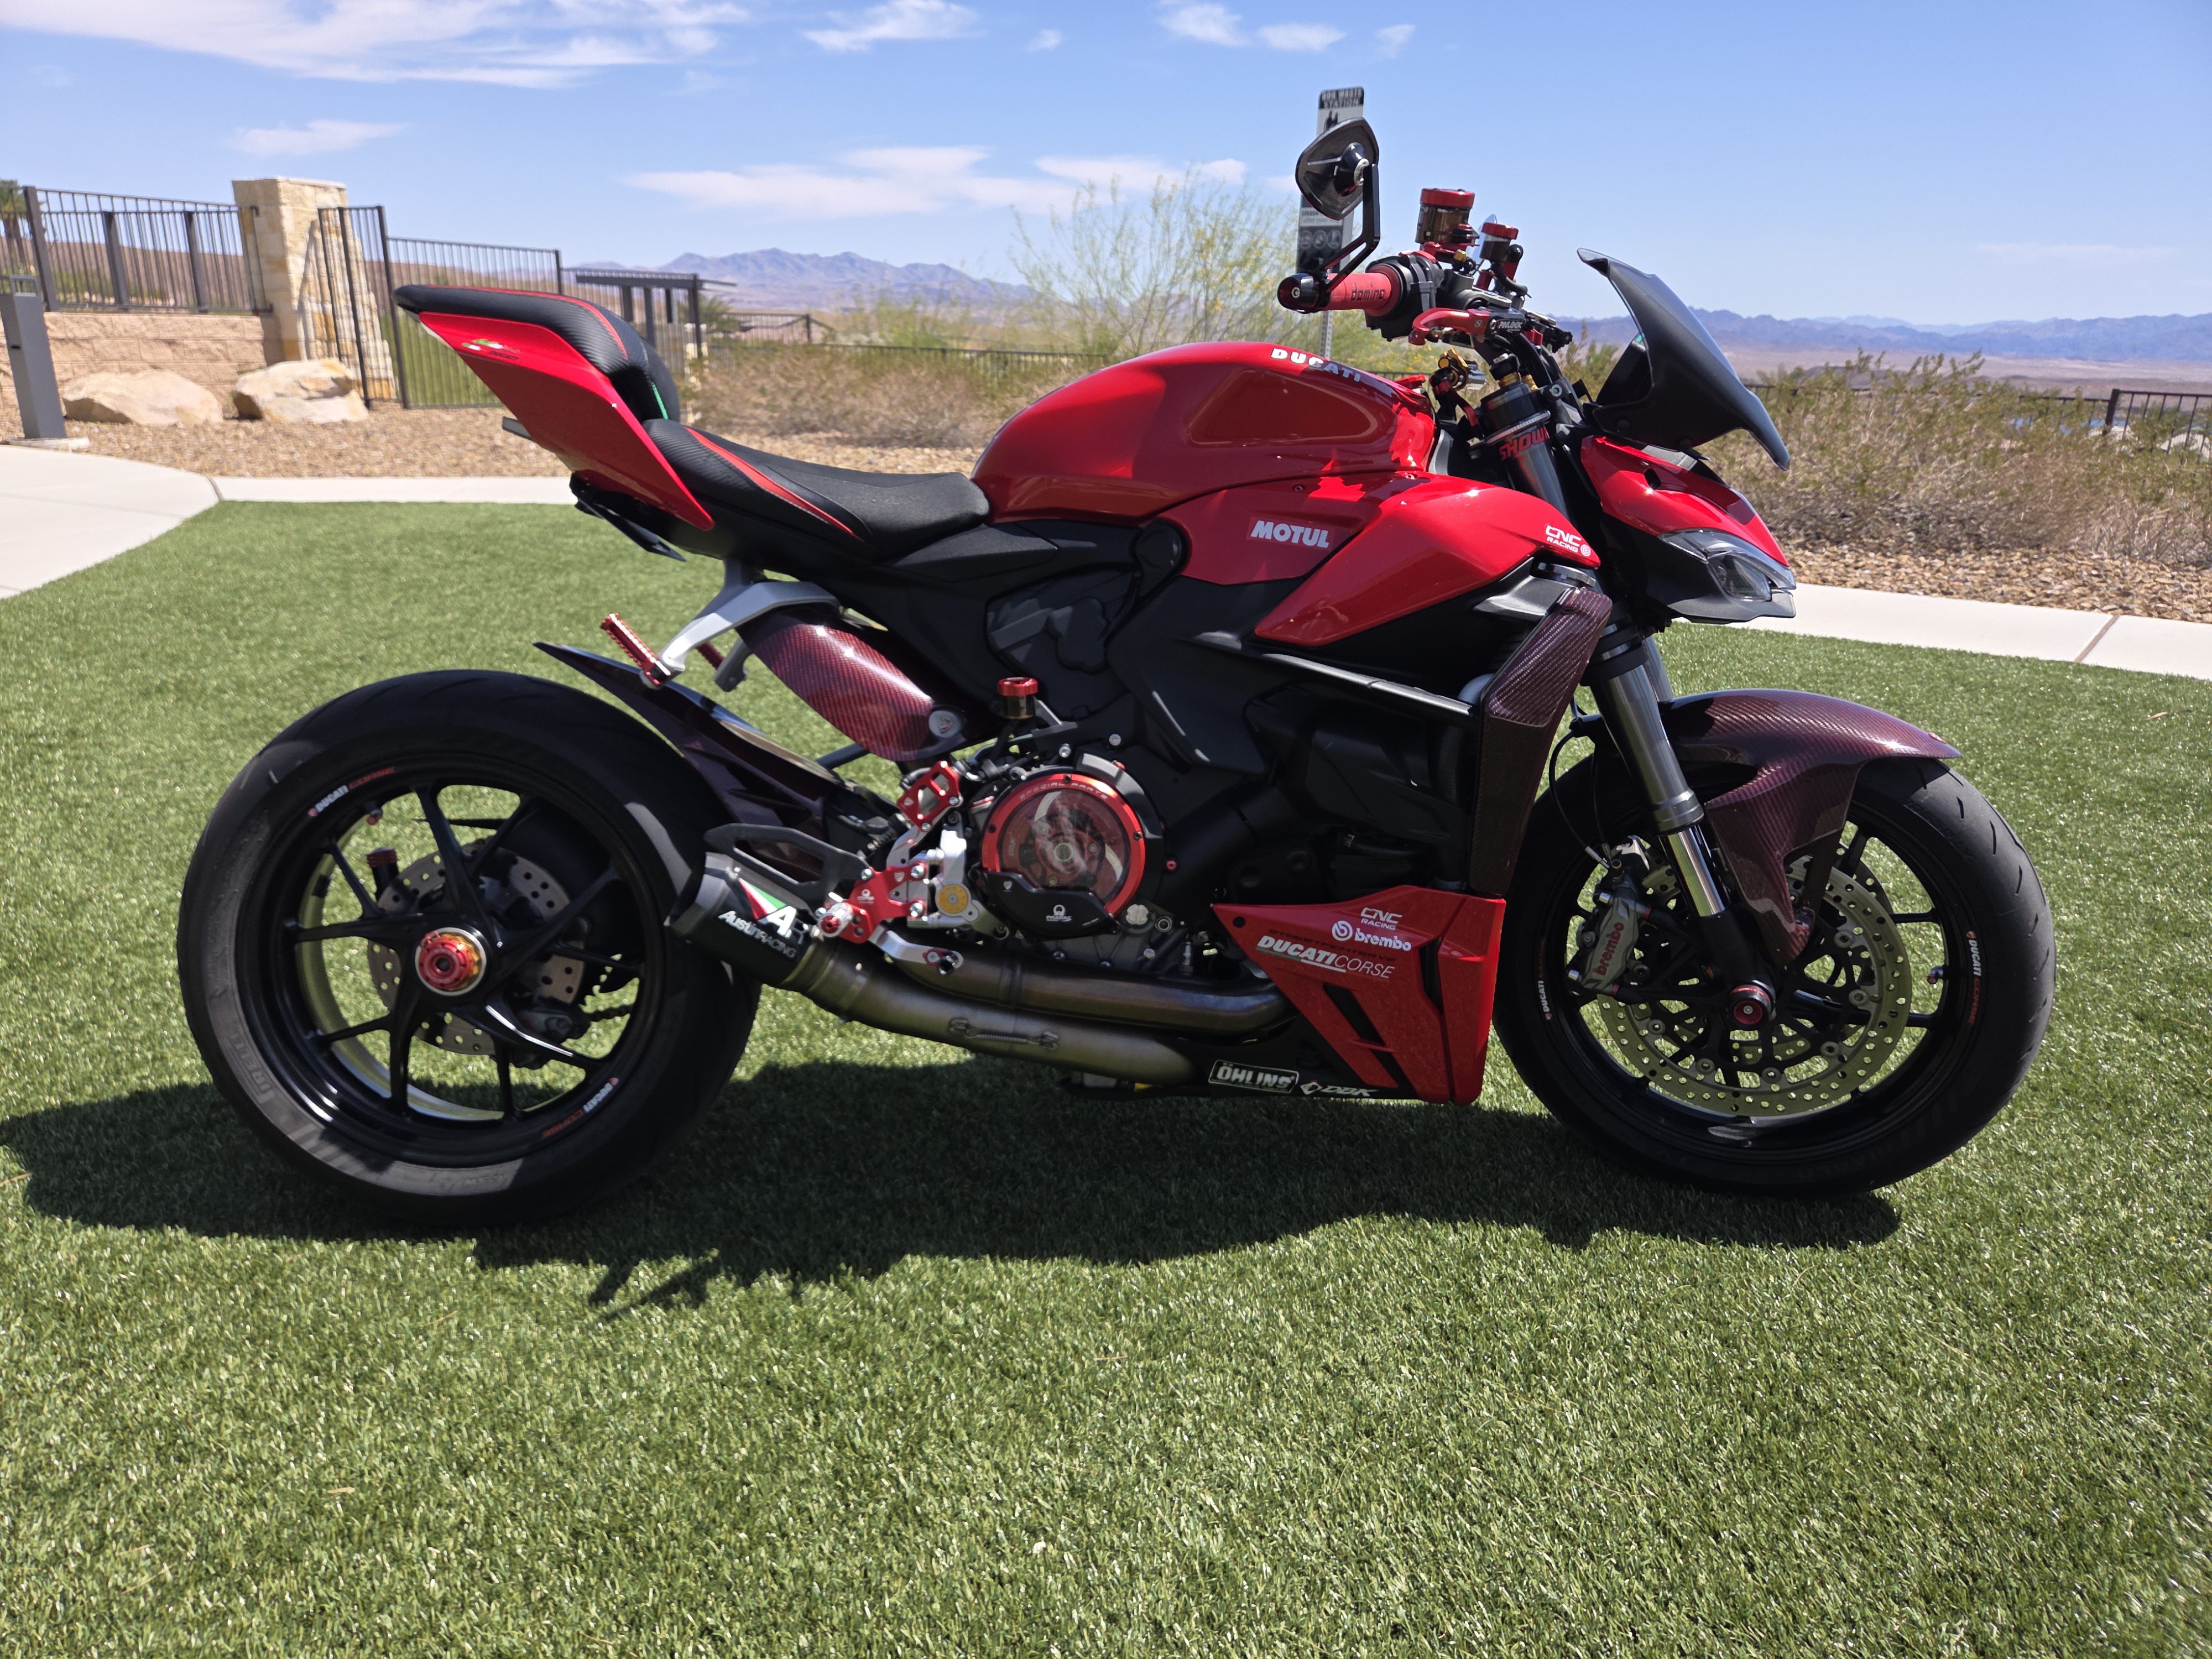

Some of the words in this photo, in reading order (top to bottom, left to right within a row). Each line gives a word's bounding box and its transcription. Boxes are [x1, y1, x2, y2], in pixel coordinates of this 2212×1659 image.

[1350, 280, 1385, 301] domino
[1271, 348, 1361, 382] DUCATI
[1250, 520, 1329, 548] MOTUL
[1546, 525, 1582, 547] CNC
[1547, 536, 1579, 553] RACING
[315, 785, 349, 812] DUCATI
[1019, 782, 1066, 800] SPECIAL
[1071, 782, 1108, 800] PARTS
[1360, 907, 1403, 924] CNC
[1361, 919, 1396, 930] RACING
[1354, 927, 1412, 951] brembo
[1593, 922, 1624, 976] brembo
[1257, 935, 1337, 964] DUCATI
[1334, 955, 1395, 978] CORSE
[1969, 939, 1981, 977] DUCATI
[1538, 980, 1550, 1012] DUCATI
[1968, 978, 1980, 1025] CORSE
[1217, 1062, 1292, 1089] ÖHLINS
[583, 1082, 613, 1113] DUCATI
[1321, 1085, 1380, 1097] DBK
